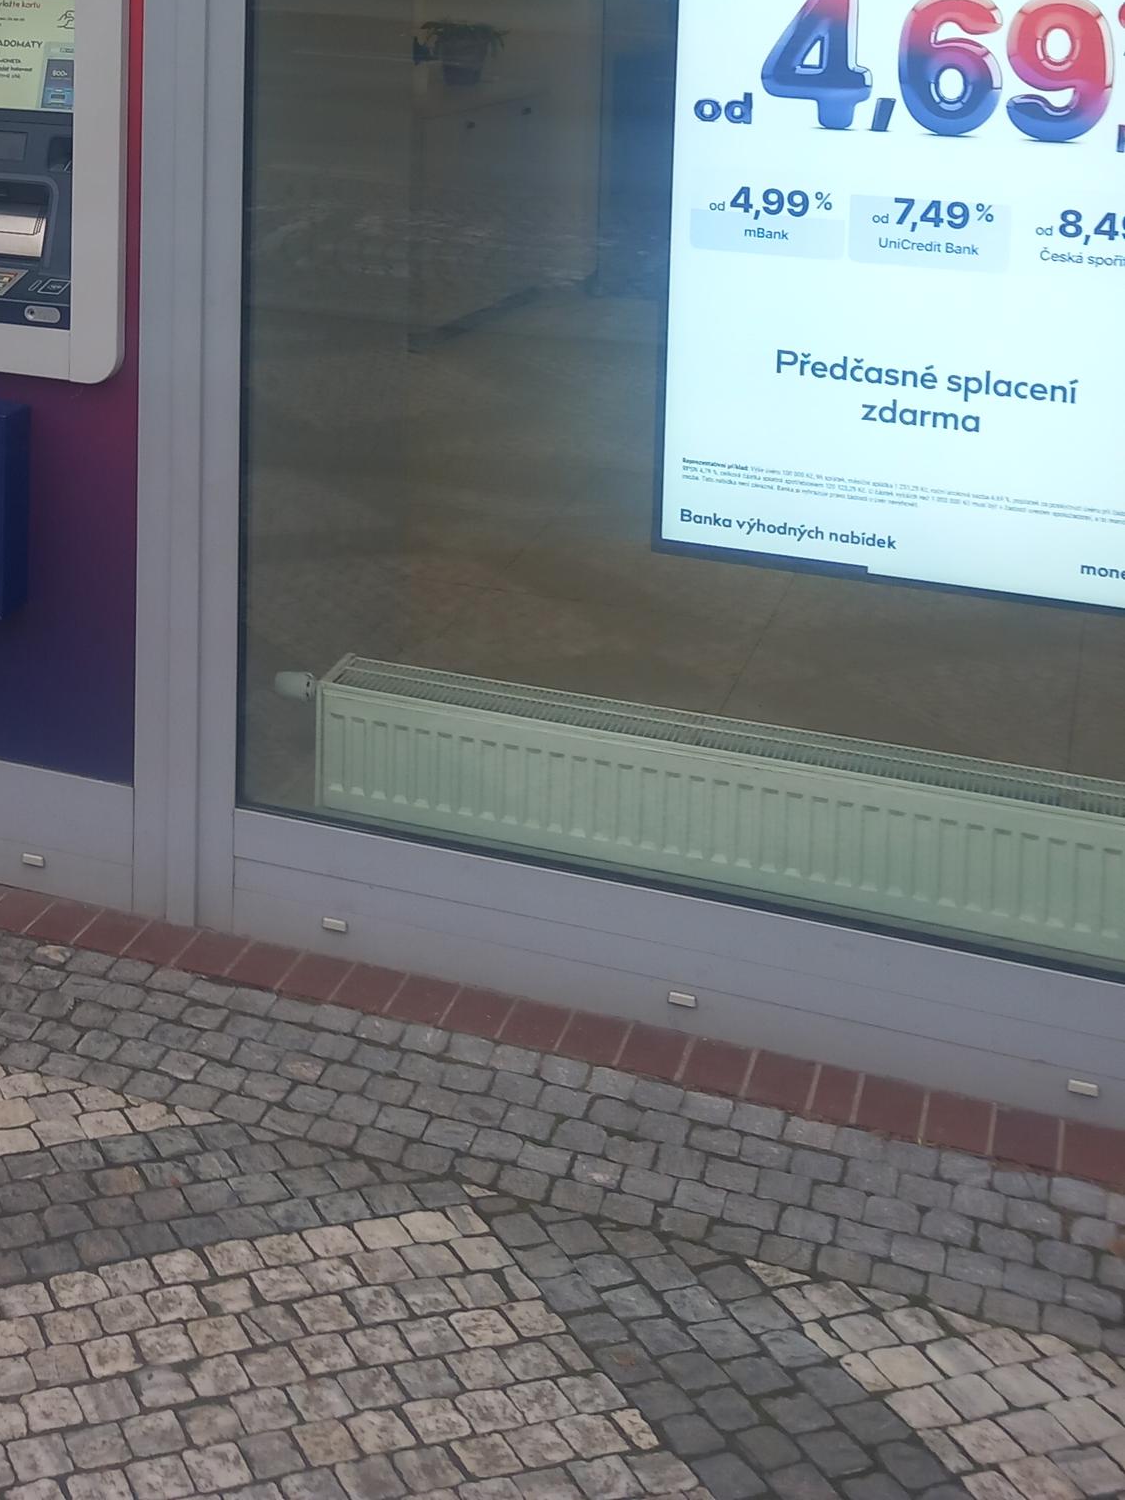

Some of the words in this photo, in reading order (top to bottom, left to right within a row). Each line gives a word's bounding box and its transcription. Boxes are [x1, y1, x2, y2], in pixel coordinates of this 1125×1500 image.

[693, 92, 754, 125] od
[709, 201, 726, 211] od
[872, 213, 889, 224] od
[744, 227, 789, 240] mBank
[1035, 225, 1053, 236] od
[1058, 209, 1125, 245] 8,4
[878, 237, 942, 253] UniCredit
[945, 243, 979, 256] Bank
[1039, 246, 1083, 264] Česká
[775, 349, 938, 390] Předčasné
[947, 370, 1079, 404] splacení
[861, 399, 981, 433] zdarma
[680, 508, 732, 528] Banka
[736, 517, 825, 542] výhodných
[829, 530, 897, 550] nabídek
